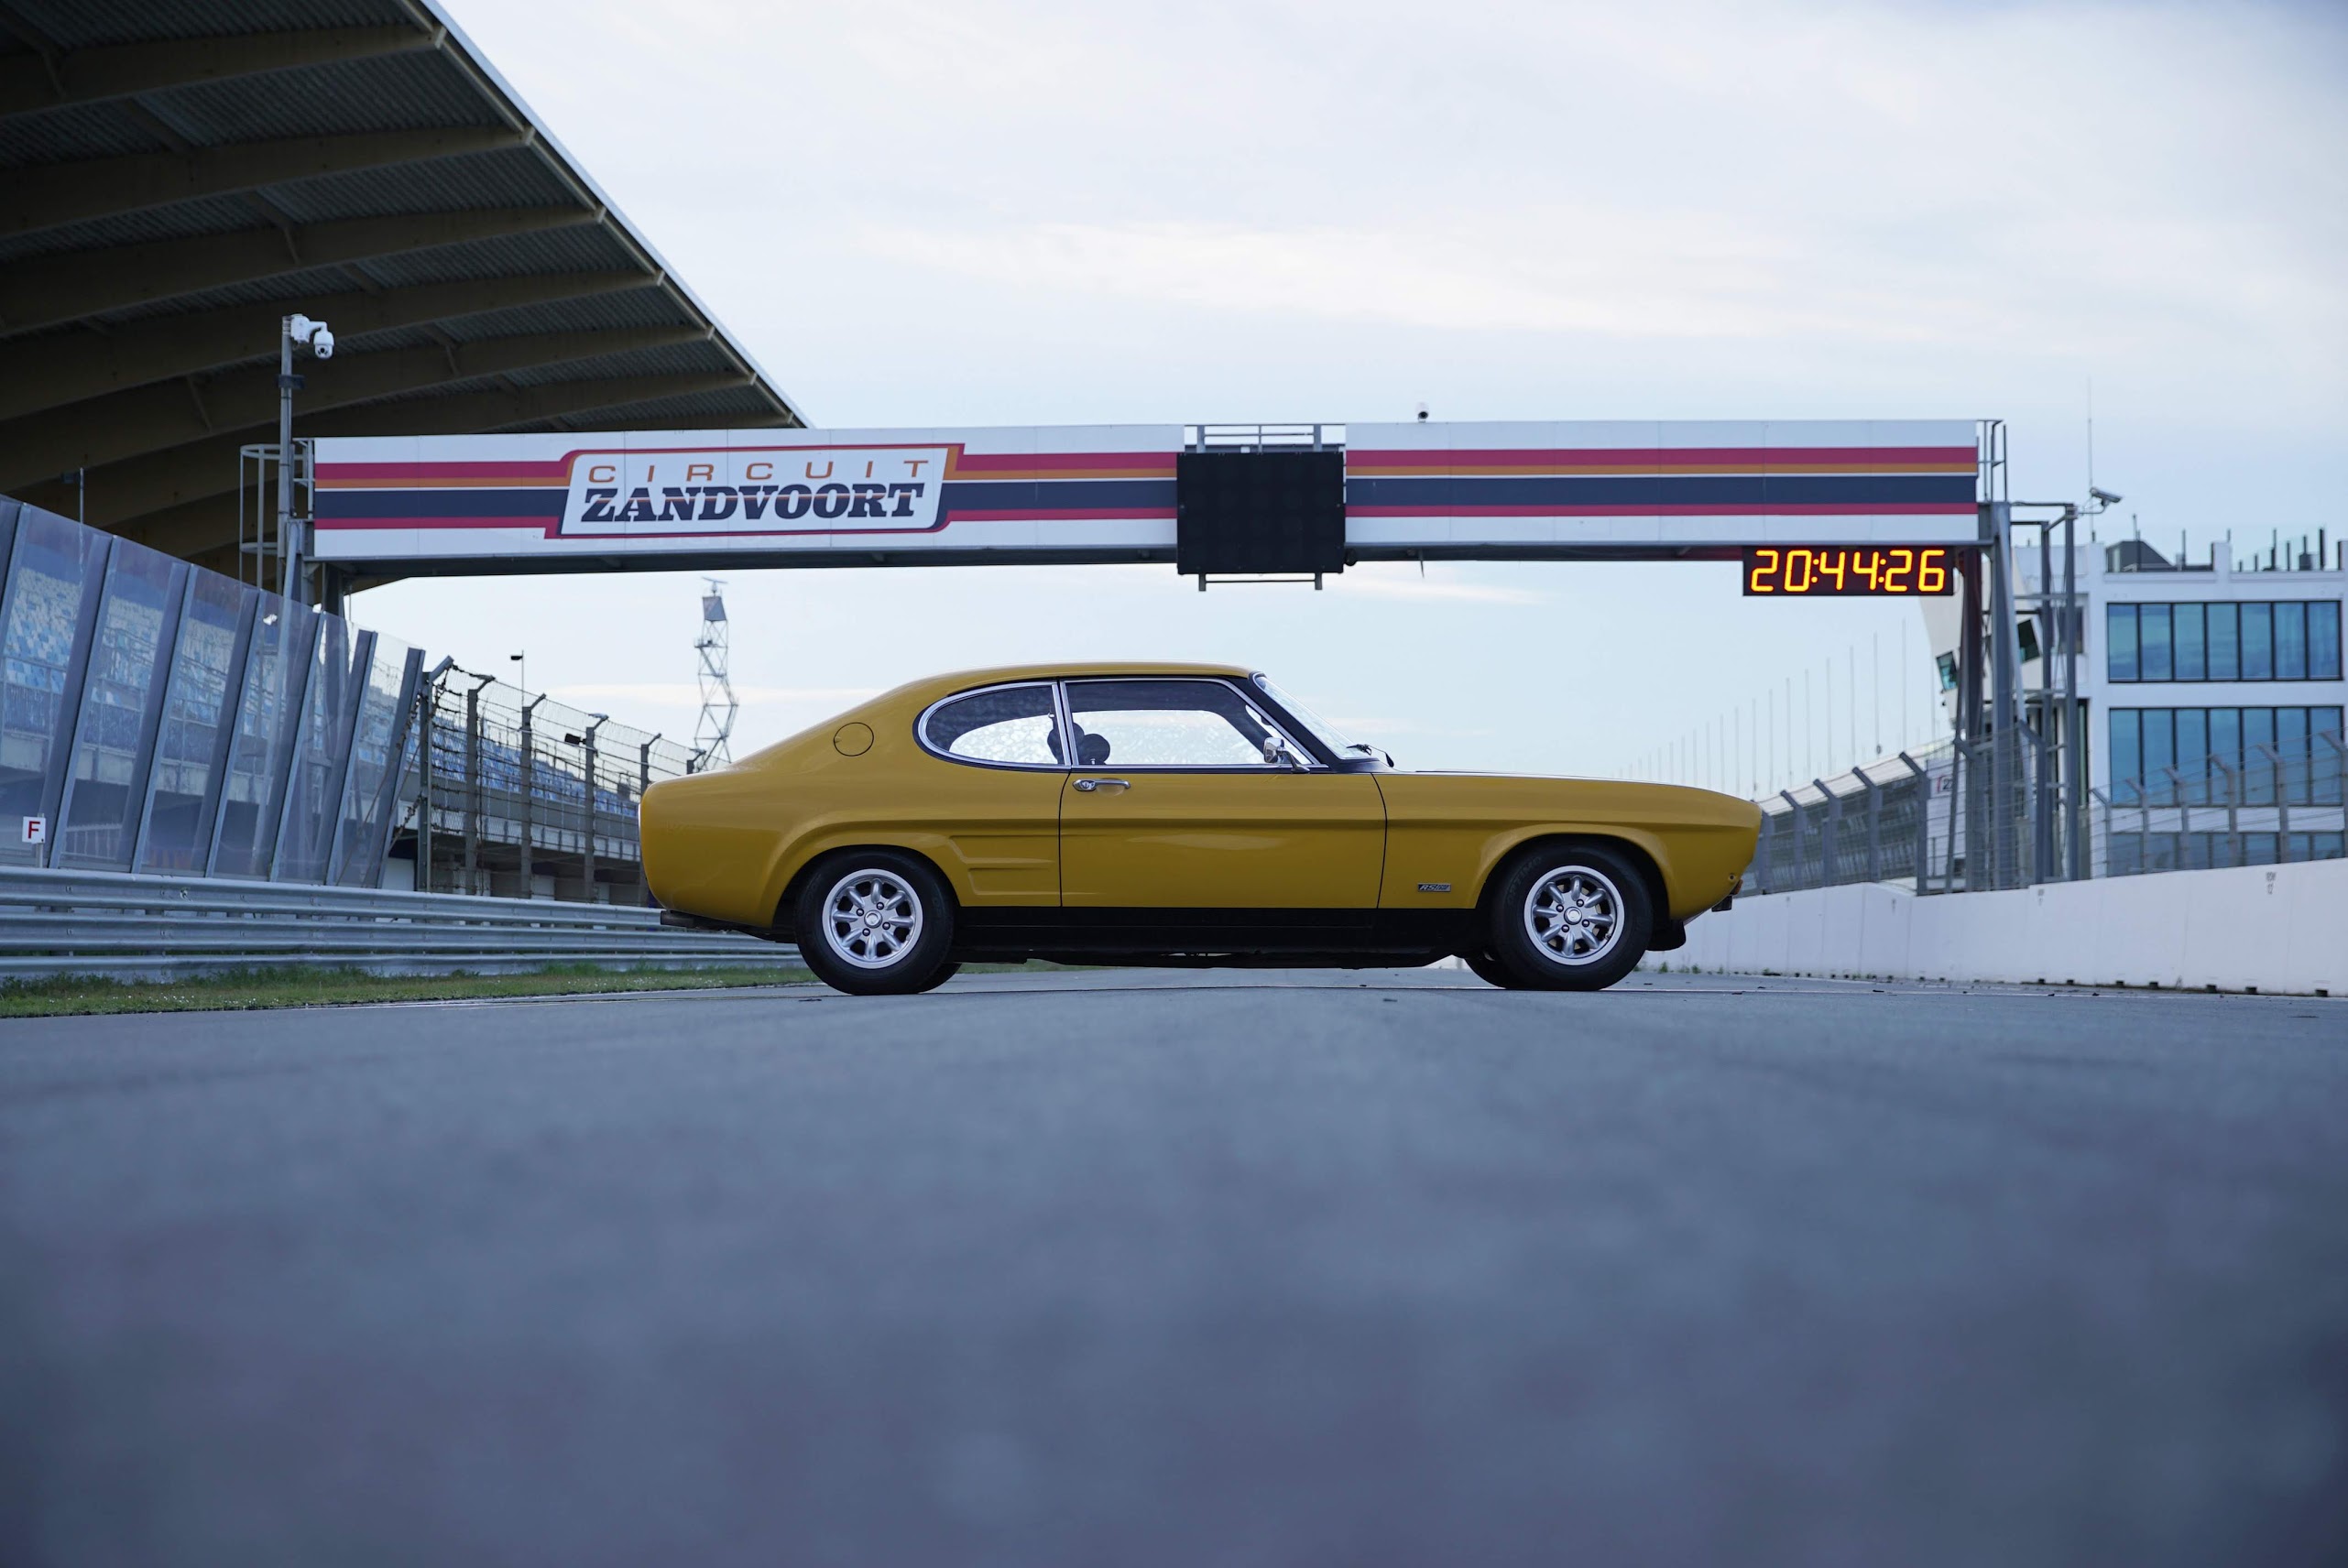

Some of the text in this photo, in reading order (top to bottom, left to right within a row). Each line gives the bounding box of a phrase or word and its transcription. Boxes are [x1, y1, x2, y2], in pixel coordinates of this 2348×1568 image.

[588, 460, 929, 484] CIRCUIT
[581, 482, 925, 522] ZANDVOORT
[1751, 550, 1945, 592] 20:44:26
[27, 821, 41, 839] F
